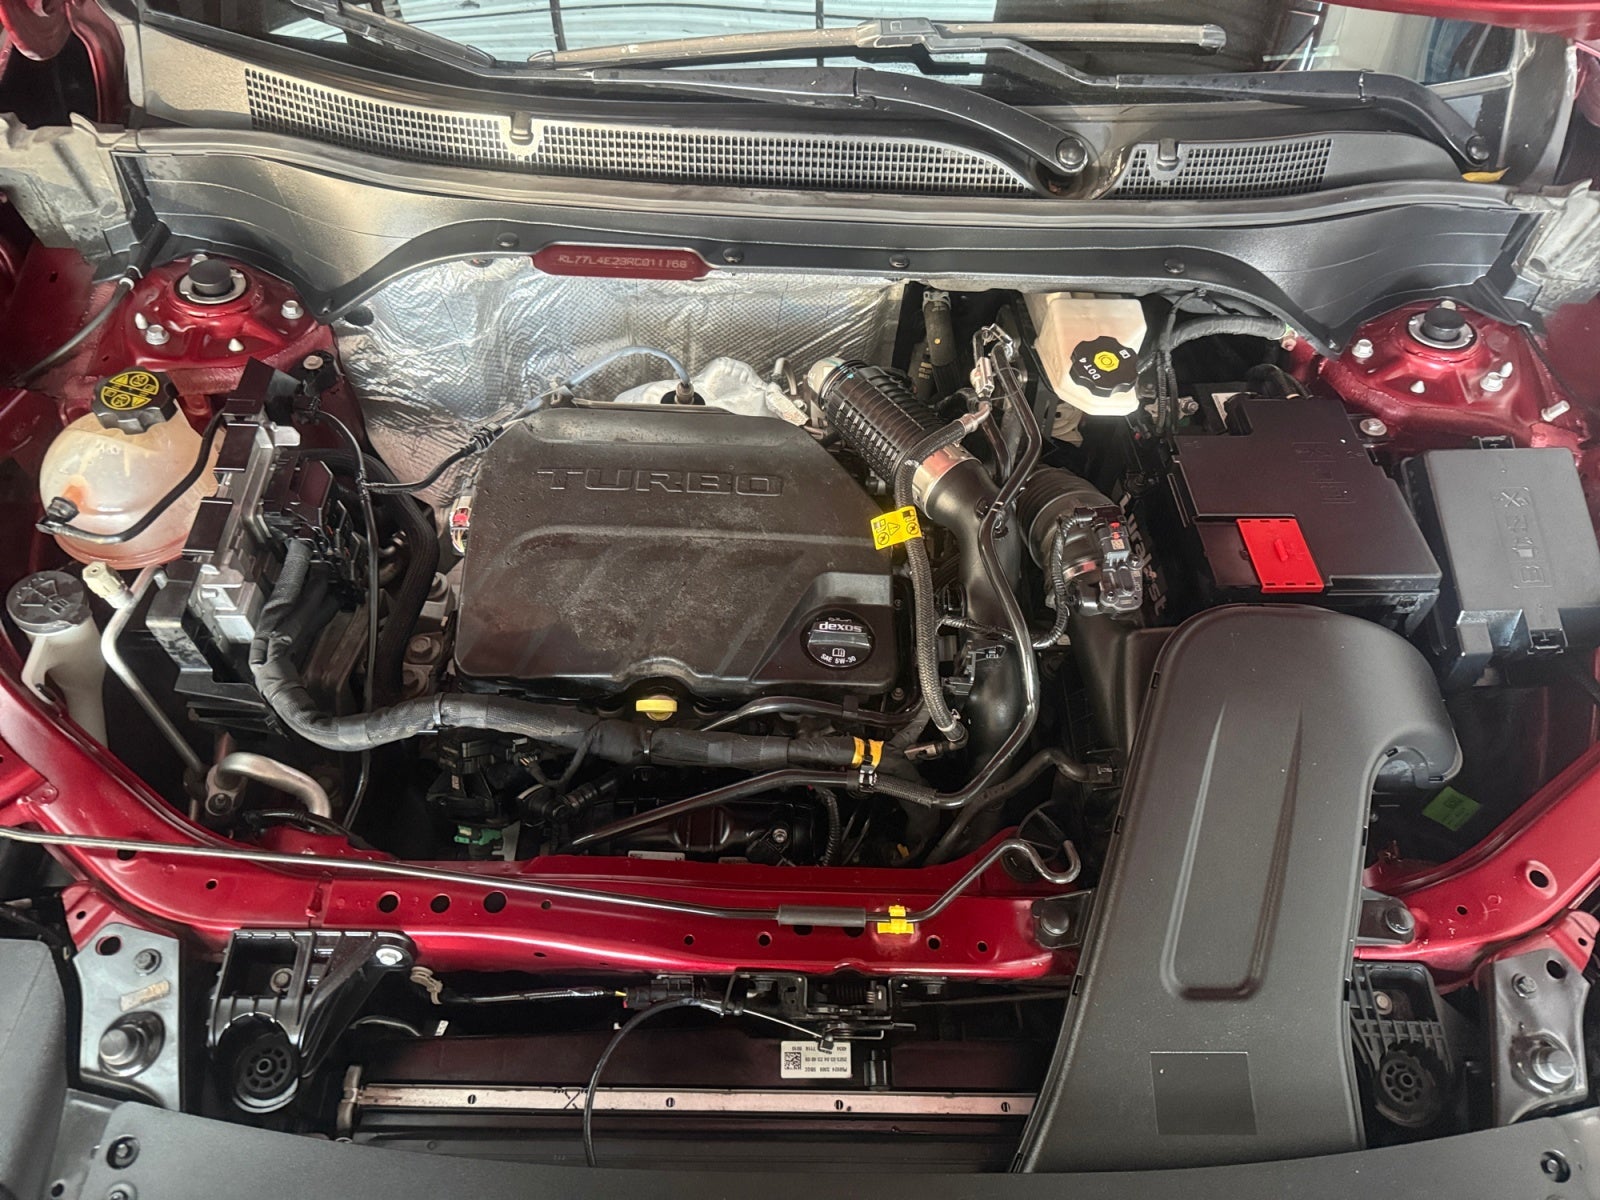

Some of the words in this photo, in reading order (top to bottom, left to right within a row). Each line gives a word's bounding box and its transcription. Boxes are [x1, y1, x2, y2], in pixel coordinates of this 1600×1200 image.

[1083, 364, 1101, 380] DOT
[536, 468, 782, 497] TURBO
[819, 621, 862, 633] dexos
[820, 653, 833, 663] SAE
[834, 655, 857, 664] 5W-30
